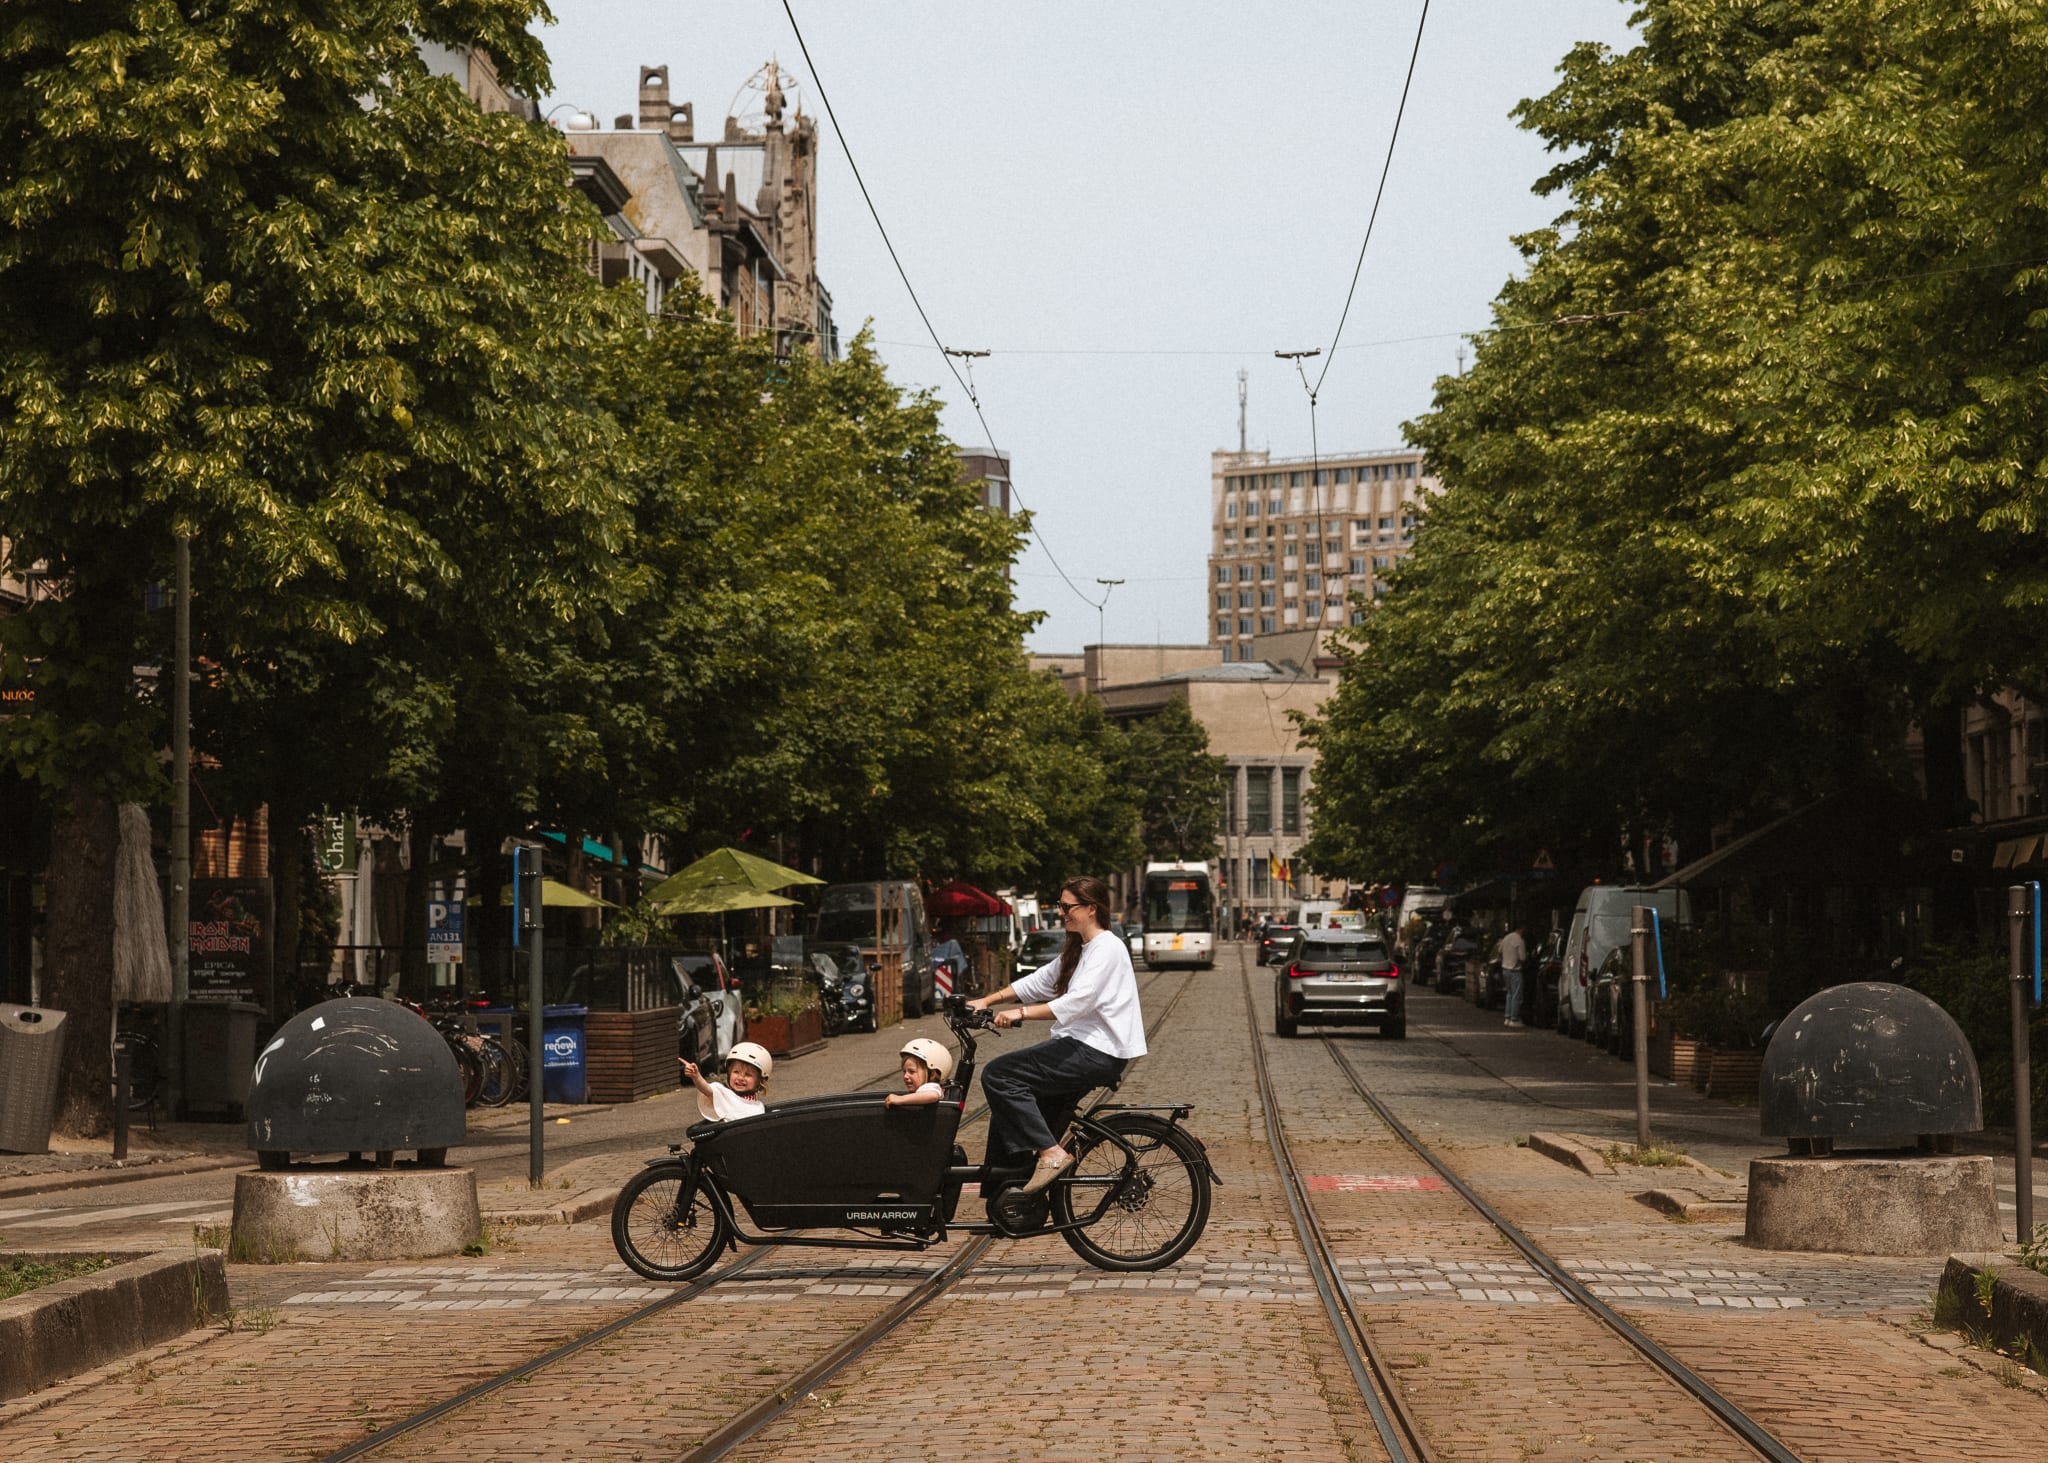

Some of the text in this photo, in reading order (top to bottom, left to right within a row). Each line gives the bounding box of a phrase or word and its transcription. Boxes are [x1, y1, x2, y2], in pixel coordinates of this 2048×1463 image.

[429, 904, 447, 928] P
[190, 921, 229, 938] IRON
[544, 1041, 577, 1051] renewi
[846, 1211, 918, 1220] URBAN ARROW
